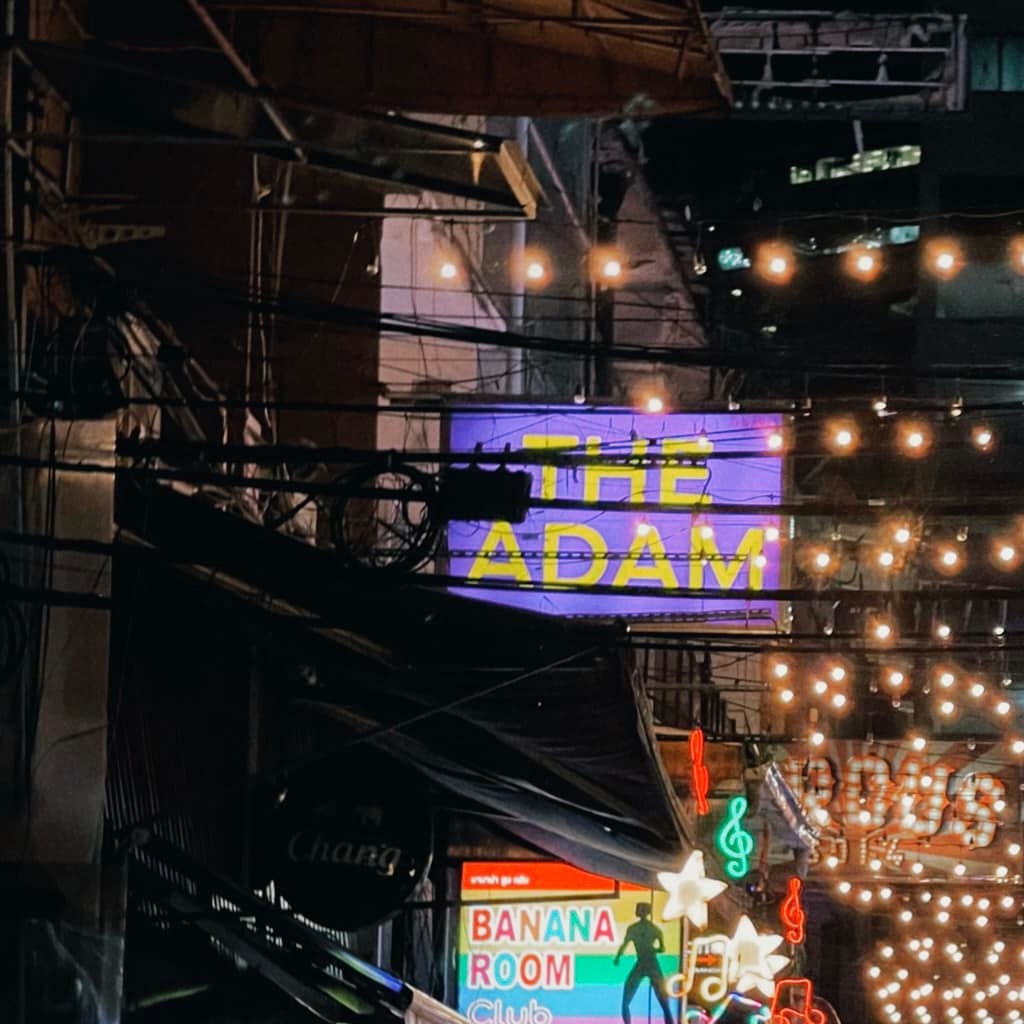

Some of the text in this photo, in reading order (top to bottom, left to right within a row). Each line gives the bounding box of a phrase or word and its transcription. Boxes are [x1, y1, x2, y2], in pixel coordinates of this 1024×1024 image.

[522, 433, 714, 506] THE
[467, 520, 768, 591] ADAM
[471, 908, 615, 943] BANANA
[470, 952, 571, 987] ROOM
